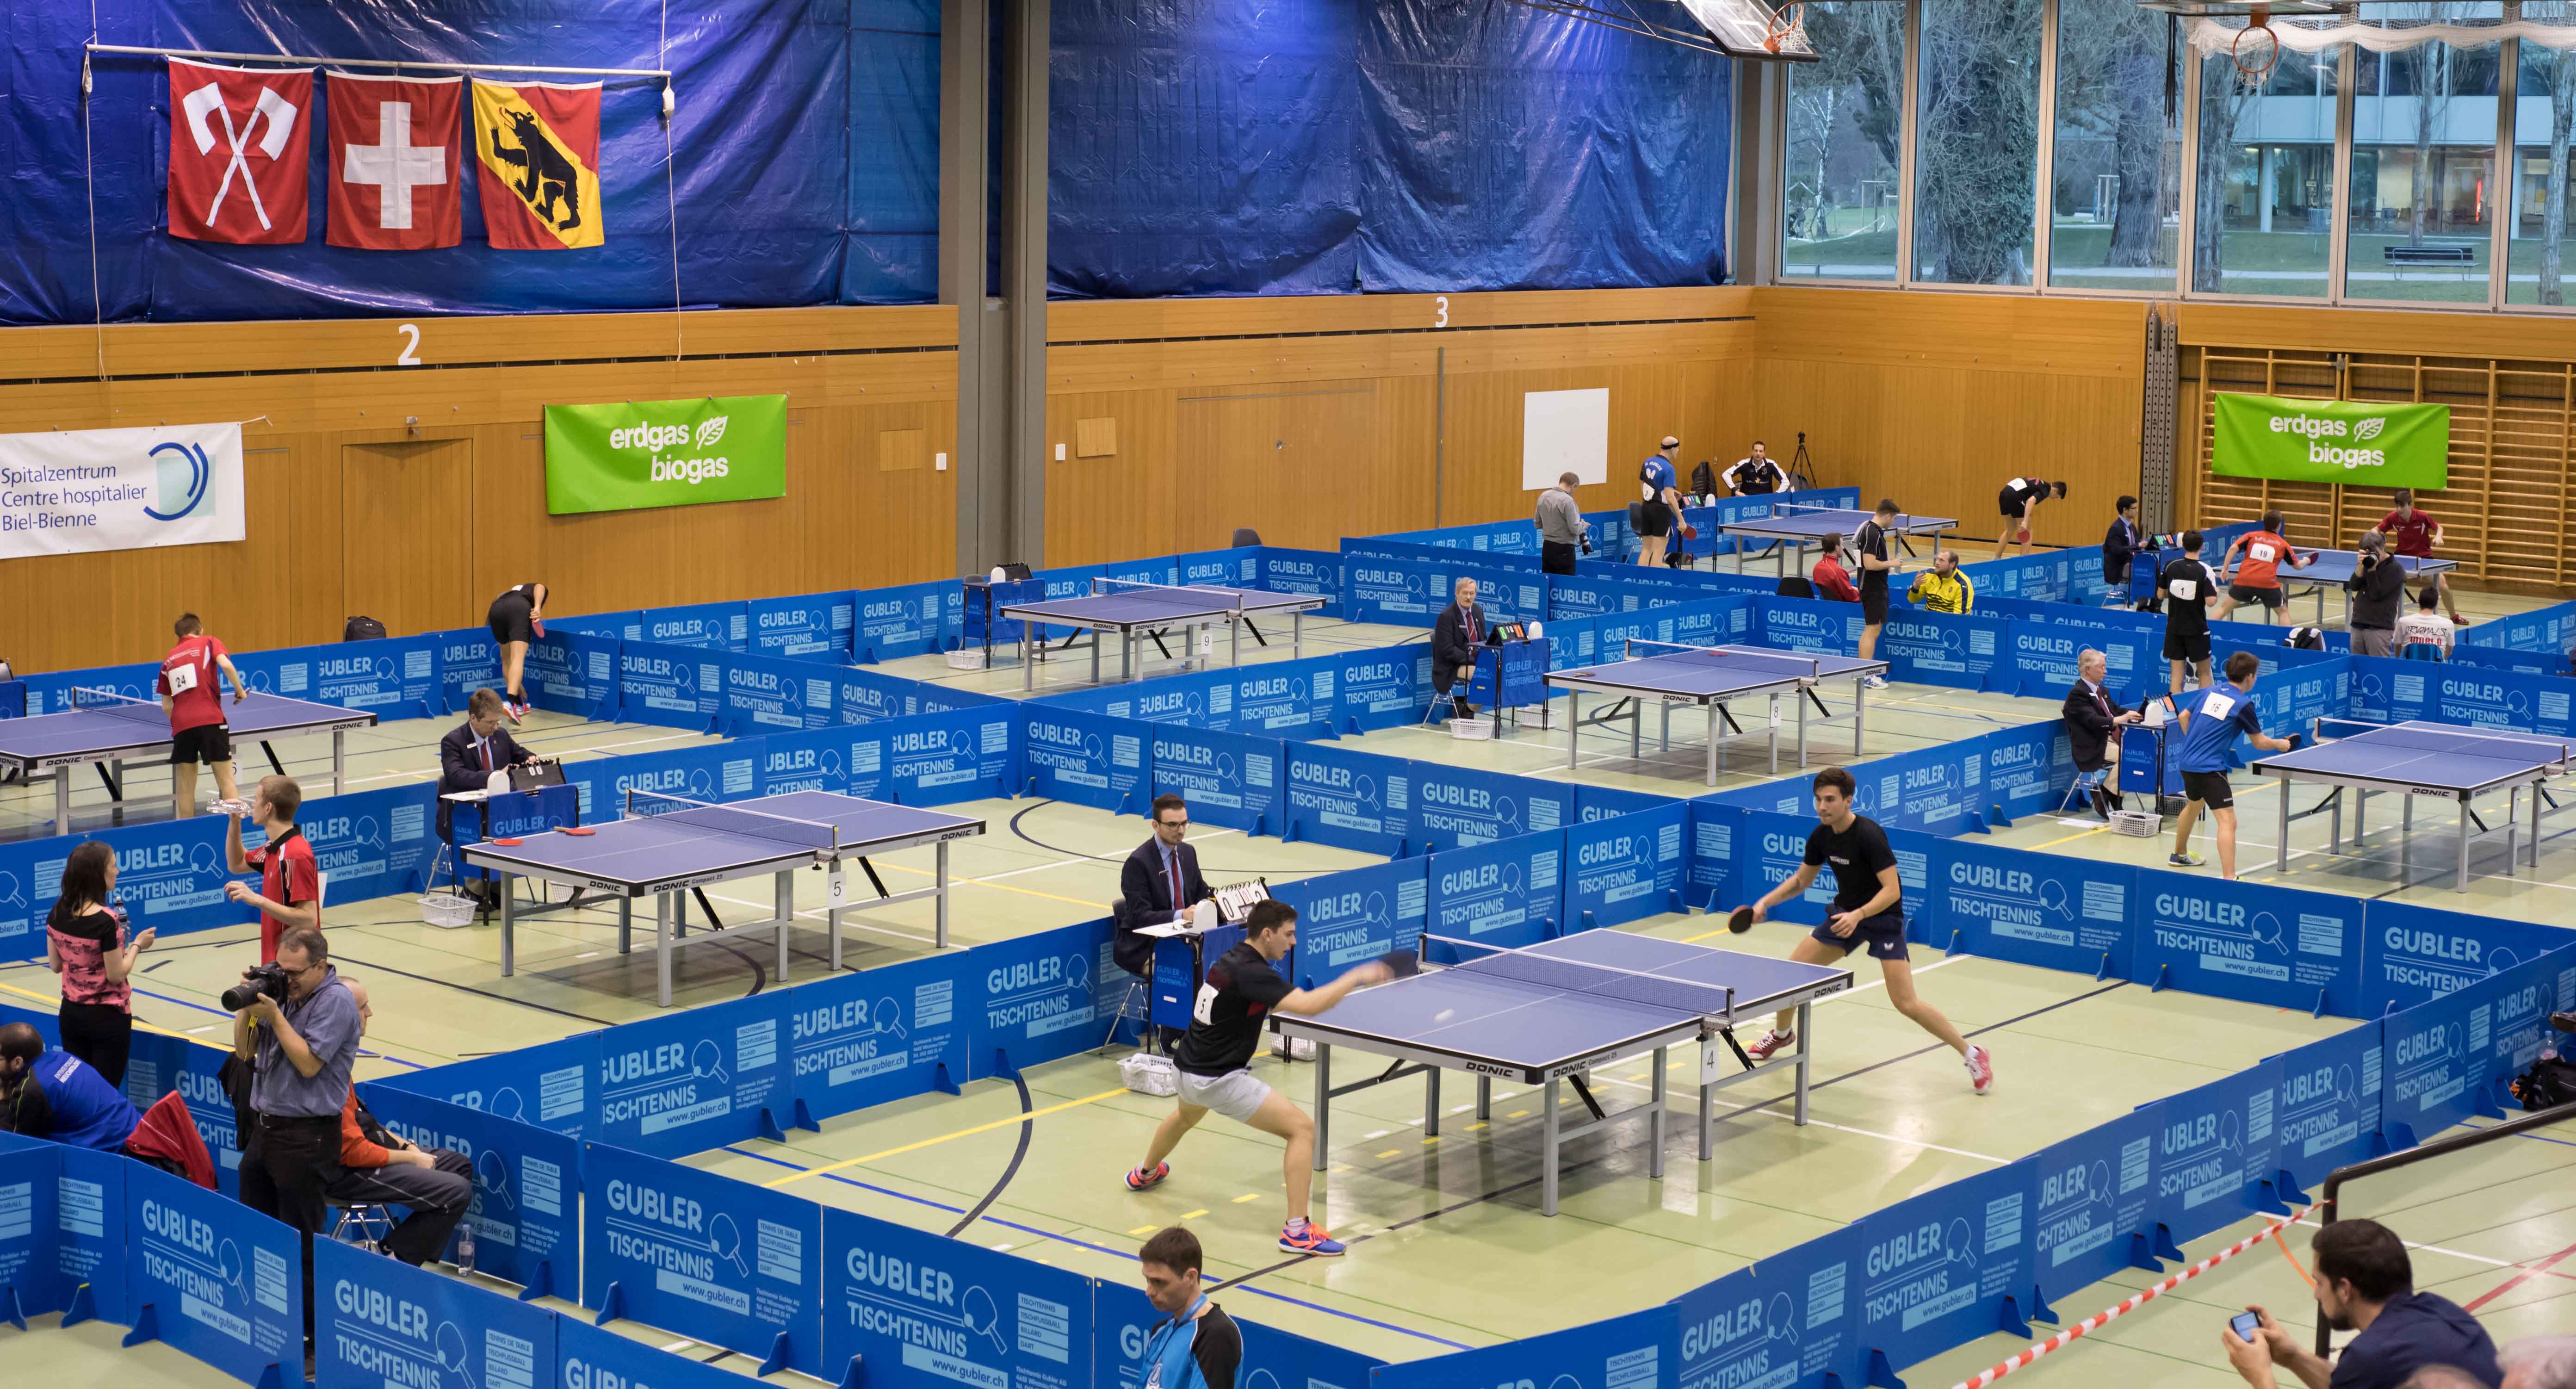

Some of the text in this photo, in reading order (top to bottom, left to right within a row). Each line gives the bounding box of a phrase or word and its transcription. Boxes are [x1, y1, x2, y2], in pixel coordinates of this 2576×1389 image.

[1436, 296, 1448, 328] 3
[397, 323, 421, 366] 2
[2270, 414, 2347, 439] erdgas
[610, 421, 689, 453] erdgas
[2309, 441, 2384, 469] biogas
[1, 464, 116, 488] Spitalzentrum
[651, 455, 729, 484] biogas
[2, 485, 147, 508] Centre hospitalier
[1742, 506, 1768, 516] GUBLER
[2, 513, 97, 532] Biel-Bienne
[1188, 563, 1223, 579] GUBLER
[1269, 559, 1313, 576] GUBLER
[2074, 558, 2102, 571] GUBLER
[1269, 580, 1319, 593] TISCHTENNIS
[1355, 569, 1403, 585] GUBLER
[1355, 589, 1409, 602] TISCHTENNIS
[1550, 587, 1596, 604] GUBLER
[759, 610, 806, 627] GUBLER
[864, 601, 902, 618] GUBLER
[1768, 609, 1817, 627] GUBLER
[653, 620, 703, 638] GUBLER
[863, 622, 906, 637] TISCHTENNIS
[1604, 626, 1639, 642] GUBLER
[1886, 622, 1939, 640] GUBLER
[760, 633, 813, 646] TISCHTENNIS
[1204, 635, 1210, 647] 9
[1768, 633, 1822, 647] TISCHTENNIS
[2018, 635, 2073, 654] GUBLER
[2018, 635, 2073, 654] GUBLER
[1886, 645, 1945, 660] TISCHTENNIS
[175, 674, 186, 688] 24
[730, 668, 777, 690] GUBLER
[1345, 663, 1392, 682] GUBLER
[843, 683, 881, 707] GUBLER
[1241, 677, 1288, 698] GUBLER
[1345, 688, 1397, 705] TISCHTENNIS
[2442, 680, 2502, 701] GUBLER
[730, 694, 783, 714] TISCHTENNIS
[1241, 703, 1293, 721] TISCHTENNIS
[1774, 706, 1779, 718] 8
[2441, 705, 2509, 724] TISCHTENNIS
[332, 721, 363, 731] DONIC
[1029, 721, 1081, 747] GUBLER
[45, 756, 81, 766] DONIC
[1029, 750, 1087, 772] TISCHTENNIS
[1154, 740, 1212, 765] GUBLER
[1992, 743, 2031, 766] GUBLER
[616, 769, 685, 793] GUBLER
[935, 771, 975, 783] www.gubler.ch
[1069, 773, 1106, 786] www.gubler.ch
[1154, 770, 1219, 792] TISCHTENNIS
[1290, 761, 1351, 788] GUBLER
[1991, 770, 2034, 791] TISCHTENNIS
[1200, 792, 1240, 806] www.gubler.ch
[1423, 782, 1490, 811] GUBLER
[2412, 788, 2450, 797] DONIC
[1290, 791, 1357, 815] TISCHTENNIS
[495, 816, 545, 835] GUBLER
[1337, 817, 1379, 830] www.gubler.ch
[1423, 813, 1499, 837] TISCHTENNIS
[941, 829, 972, 840] DONIC
[1579, 837, 1631, 865] GUBLER
[336, 863, 383, 878] www.gubler.ch
[1442, 864, 1499, 896] GUBLER
[1951, 862, 2033, 894] GUBLER
[589, 881, 620, 892] DONIC
[653, 880, 690, 892] DONIC
[833, 881, 842, 897] 5
[1578, 868, 1636, 894] TISCHTENNIS
[167, 891, 222, 908] www.gubler.ch
[1441, 897, 1504, 926] TISCHTENNIS
[1950, 897, 2042, 925] TISCHTENNIS
[2155, 893, 2245, 927] GUBLER
[1485, 912, 1523, 928] www.gubler.ch
[2014, 926, 2071, 943] www.gubler.ch
[2155, 930, 2254, 960] TISCHTENNIS
[2384, 927, 2481, 963] GUBLER
[987, 956, 1060, 994] GUBLER
[2224, 960, 2285, 979] www.gubler.ch
[1814, 984, 1841, 998] DONIC
[987, 994, 1069, 1029] TISCHTENNIS
[1046, 1009, 1092, 1029] www.gubler.ch
[738, 1023, 767, 1035] TISCHTENNIS
[2396, 1022, 2445, 1065] GUBLER
[851, 1055, 905, 1076] www.gubler.ch
[1553, 1061, 1586, 1078] DONIC
[1588, 1054, 1610, 1065] Compact
[1707, 1050, 1714, 1069] 4
[543, 1069, 574, 1082] TISCHTENNIS
[1466, 1062, 1513, 1077] DONIC
[2395, 1065, 2449, 1103] TISCHTENNIS
[667, 1102, 727, 1125] www.gubler.ch
[60, 1179, 92, 1193] TISCHTENNIS
[607, 1179, 702, 1233] GUBLER
[142, 1199, 214, 1259] GUBLER
[607, 1230, 713, 1281] TISCHTENNIS
[1866, 1222, 1942, 1277] GUBLER
[143, 1251, 223, 1309] TISCHTENNIS
[847, 1247, 954, 1306] GUBLER
[682, 1282, 746, 1308] www.gubler.ch
[1020, 1296, 1055, 1312] TISCHTENNIS
[1865, 1270, 1948, 1325] TISCHTENNIS
[1922, 1289, 1974, 1318] www.gubler.ch
[335, 1279, 428, 1343] GUBLER
[1020, 1310, 1061, 1329] TISCHFUSSBALL
[201, 1308, 248, 1339] www.gubler.ch
[847, 1301, 967, 1357] TISCHTENNIS
[1020, 1326, 1042, 1338] BILLARD
[1682, 1298, 1762, 1361] GUBLER
[489, 1331, 508, 1346] TENNIS
[1020, 1340, 1034, 1351] DART
[335, 1334, 440, 1389] TISCHTENNIS
[488, 1347, 526, 1367] TISCHFUSSBALL
[1609, 1352, 1646, 1368] TISCHTENNIS
[488, 1363, 508, 1375] BILLARD
[932, 1358, 1004, 1388] www.gubler.ch
[1609, 1366, 1650, 1384] TISCHFUSSBALL
[488, 1378, 502, 1389] DART
